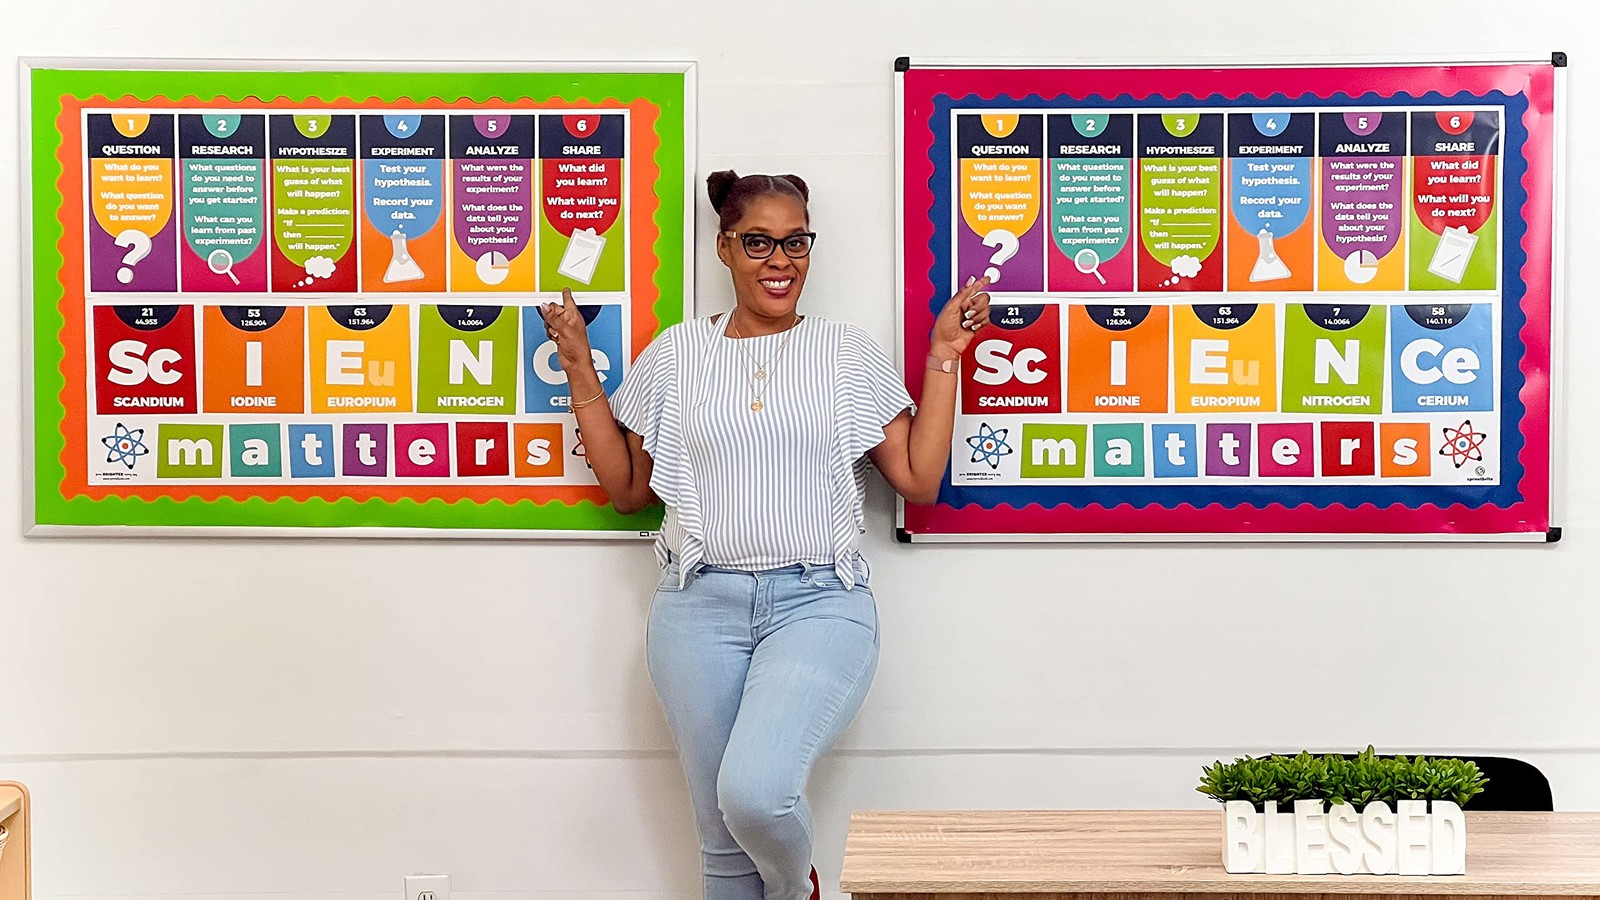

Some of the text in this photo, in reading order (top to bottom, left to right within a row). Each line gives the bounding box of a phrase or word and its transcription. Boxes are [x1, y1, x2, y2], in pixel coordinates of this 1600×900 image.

[127, 119, 134, 131] 1
[217, 119, 227, 132] 2
[308, 120, 317, 132] 3
[397, 120, 408, 132] 4
[487, 120, 497, 132] 5
[577, 119, 587, 132] 6
[997, 119, 1003, 131] 1
[1085, 119, 1096, 131] 2
[1176, 119, 1185, 131] 3
[1266, 118, 1277, 130] 4
[1358, 117, 1368, 129] 5
[1450, 116, 1461, 128] 6
[102, 145, 161, 156] QUESTION
[191, 145, 253, 155] RESEARCH
[278, 147, 348, 156] HYPOTHESIZE
[371, 147, 435, 156] EXPERIMENT
[465, 146, 519, 155] ANALYZE
[562, 145, 601, 155] SHARE
[971, 145, 1029, 156] QUESTION
[1060, 145, 1121, 155] RESEARCH
[1146, 146, 1215, 155] HYPOTHESIZE
[1239, 145, 1304, 154] EXPERIMENT
[1335, 143, 1390, 153] ANALYZE
[1434, 142, 1475, 152] SHARE
[105, 163, 128, 171] What
[276, 165, 300, 173] What
[379, 164, 427, 175] Test your
[558, 163, 605, 173] What did
[1057, 163, 1124, 172] What questions
[1247, 163, 1295, 173] Test your
[1330, 162, 1355, 170] What
[1379, 161, 1395, 169] the
[136, 174, 163, 182] learn?
[284, 179, 309, 187] guess
[310, 177, 320, 185] of
[1059, 174, 1122, 183] do you need to
[1241, 175, 1301, 187] hypothesis.
[1331, 172, 1394, 182] results of your
[374, 177, 432, 189] hypothesis.
[555, 177, 608, 188] you learn?
[1093, 184, 1121, 192] before
[1334, 183, 1389, 193] experiment?
[304, 190, 340, 199] happen?
[373, 197, 434, 208] Record your
[546, 196, 617, 207] What will you
[1056, 195, 1125, 205] you get started?
[1240, 195, 1302, 207] Record your
[1330, 202, 1394, 210] What does the
[307, 208, 350, 216] prediction:
[390, 210, 416, 220] data.
[560, 210, 604, 219] do next?
[1257, 209, 1284, 218] data.
[1334, 212, 1389, 222] data tell you
[1061, 215, 1085, 223] What
[1103, 216, 1120, 224] you
[1104, 226, 1123, 235] past
[1338, 223, 1386, 233] about your
[1062, 236, 1120, 246] experiments?
[1336, 234, 1388, 244] hypothesis?
[141, 307, 153, 317] 21
[247, 309, 261, 318] 53
[354, 307, 367, 317] 63
[466, 308, 474, 317] 7
[1007, 307, 1019, 316] 21
[1112, 308, 1126, 317] 53
[1218, 306, 1232, 316] 63
[1333, 307, 1341, 316] 7
[1431, 307, 1445, 316] 58
[1106, 318, 1132, 326] 126.904
[107, 340, 183, 385] Sc
[246, 341, 262, 386] I
[326, 340, 395, 386] Eu
[449, 340, 493, 386] N
[973, 339, 1048, 385] Sc
[1110, 340, 1127, 386] I
[1190, 339, 1260, 385] Eu
[1314, 339, 1360, 385] N
[1400, 338, 1481, 385] Ce
[113, 397, 184, 407] SCANDIUM
[231, 396, 276, 407] IODINE
[327, 397, 396, 407] EUROPIUM
[437, 396, 504, 407] NITROGEN
[978, 396, 1048, 407] SCANDIUM
[1095, 396, 1140, 406] IODINE
[1191, 396, 1260, 407] EUROPIUM
[1302, 396, 1370, 406] NITROGEN
[1417, 395, 1469, 406] CERIUM
[1226, 800, 1466, 875] BLESSED
